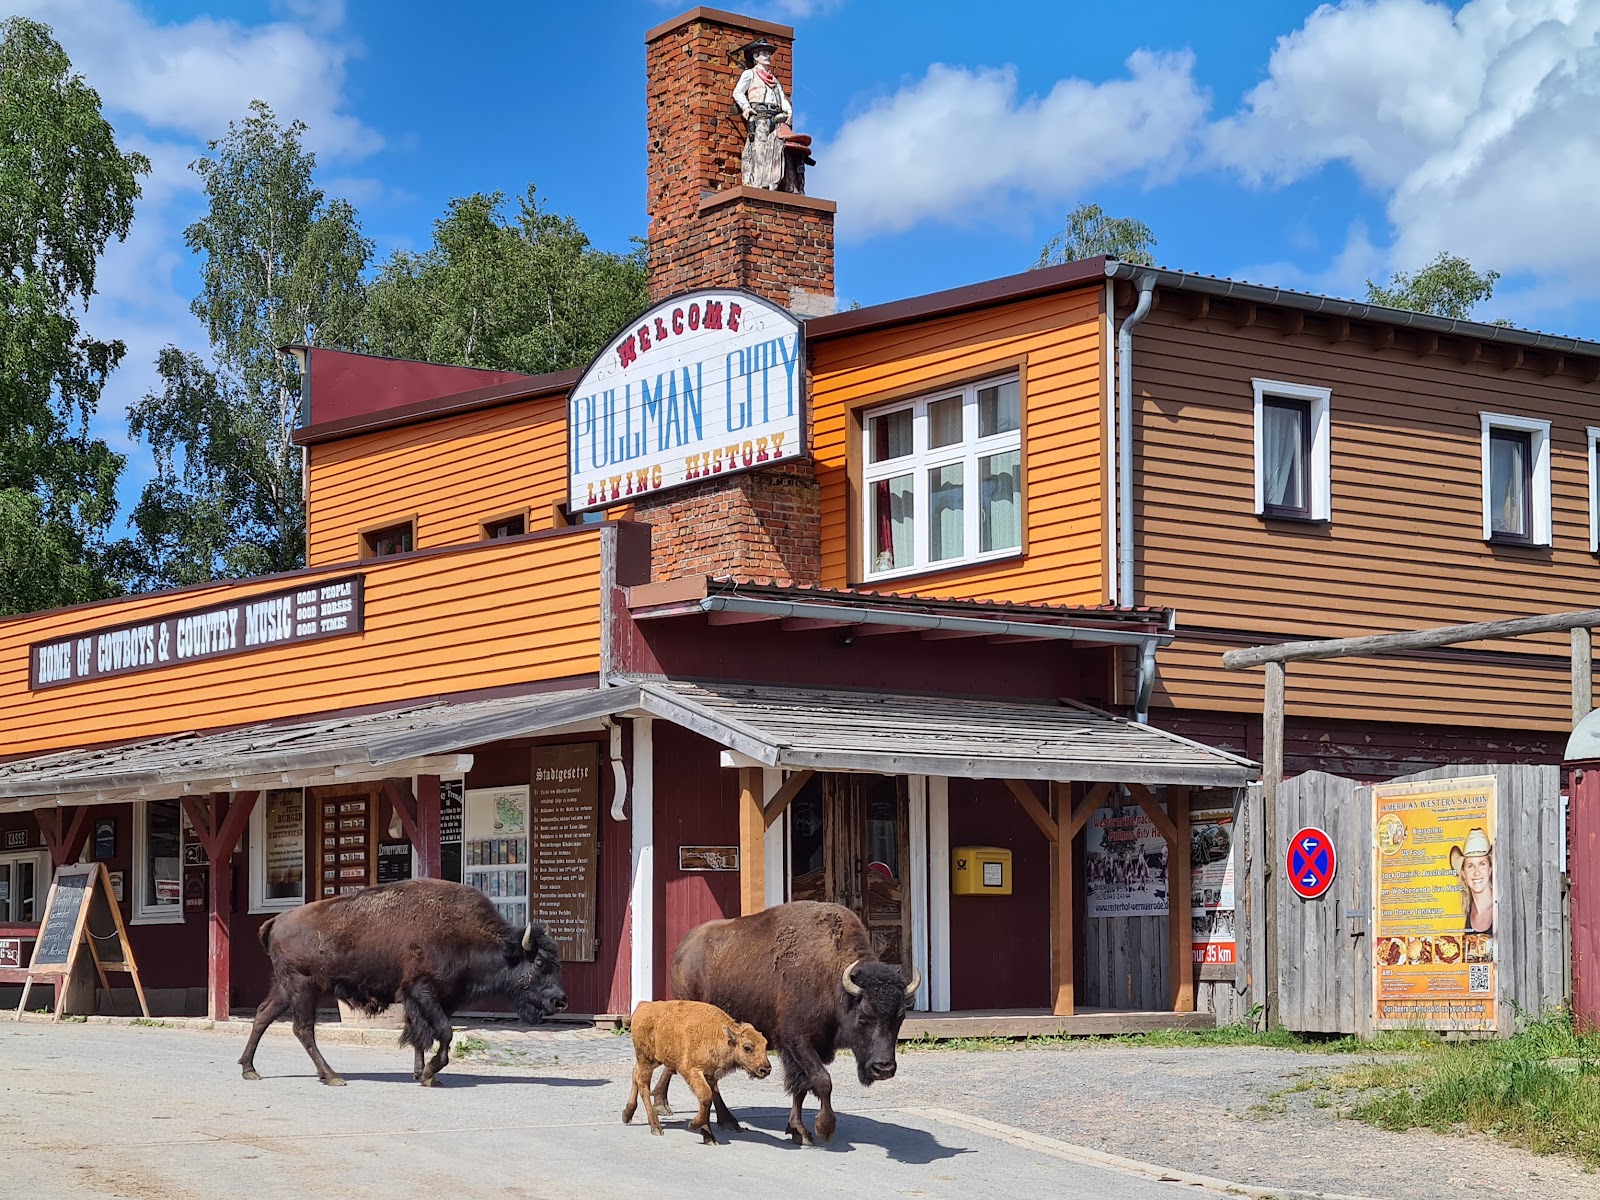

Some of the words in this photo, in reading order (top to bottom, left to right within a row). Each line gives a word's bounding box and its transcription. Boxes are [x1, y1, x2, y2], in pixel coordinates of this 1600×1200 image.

[617, 300, 742, 368] WELCOME
[574, 361, 703, 475] PULLMAN
[726, 332, 799, 433] CITY
[587, 464, 662, 505] LIVING
[685, 432, 785, 480] HISTORY
[296, 589, 316, 605] GOOD
[320, 582, 351, 600] PEOPLE
[296, 605, 316, 620] GOOD
[320, 598, 352, 616] HORSES
[296, 621, 316, 636] GOOD
[320, 615, 347, 632] TIMES
[38, 642, 71, 684] HOME
[77, 639, 91, 676] OF
[97, 625, 154, 673] COWBOYS
[158, 621, 170, 661] &
[176, 608, 239, 658] COUNTRY
[245, 596, 291, 647] MUSIC
[535, 765, 588, 782] Stadtgesetze
[1381, 801, 1418, 811] AMERICAN
[1420, 798, 1456, 808] WESTERN
[1457, 795, 1487, 805] SALOON
[1136, 815, 1152, 825] nac
[7, 831, 25, 845] KASSE
[1137, 828, 1150, 838] City
[1151, 827, 1161, 837] Ha
[1410, 848, 1425, 856] Food
[1396, 870, 1420, 878] Daniel's
[1422, 868, 1457, 877] Ausstellung
[1392, 887, 1431, 895] Wochenende
[1432, 885, 1445, 893] Live
[1394, 908, 1414, 916] Dance
[1415, 907, 1444, 915] Tanzkurse
[1206, 945, 1217, 962] 35
[1218, 944, 1232, 962] km
[1383, 1005, 1393, 1013] Our
[1394, 1005, 1409, 1013] beers
[1428, 1005, 1440, 1013] cold
